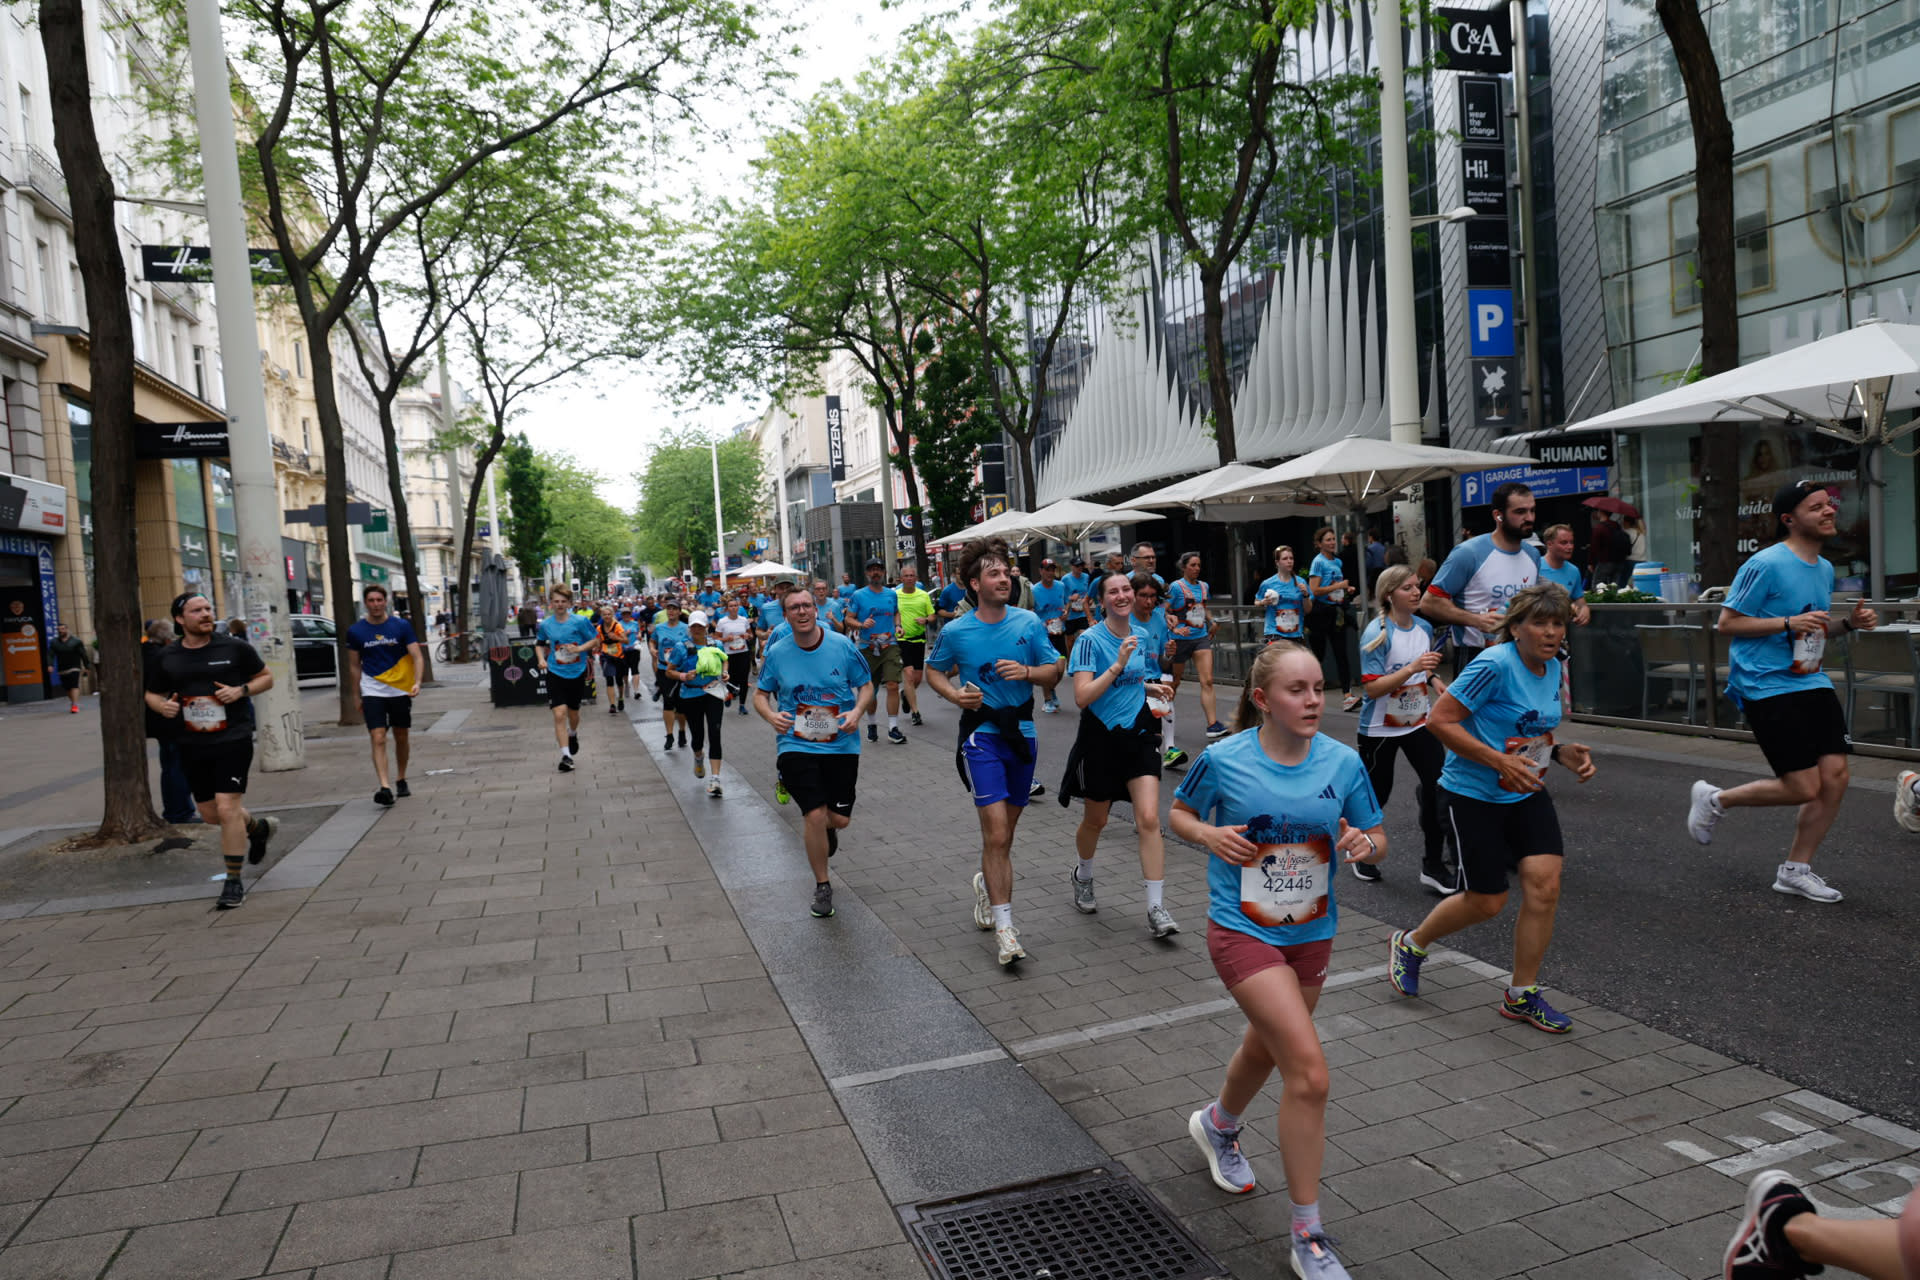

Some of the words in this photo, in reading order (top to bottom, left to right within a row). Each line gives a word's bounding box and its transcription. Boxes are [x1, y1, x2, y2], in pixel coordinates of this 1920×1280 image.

[1450, 22, 1502, 56] C&A
[1469, 111, 1487, 119] wear
[1469, 127, 1496, 136] change
[1465, 159, 1489, 179] Hi!
[1477, 303, 1504, 342] P
[1540, 445, 1608, 463] HUMANIC
[1485, 469, 1523, 483] GARAGE
[1465, 481, 1479, 503] P
[758, 540, 768, 549] U
[1263, 875, 1313, 893] 42445
[1311, 903, 1318, 914] 3
